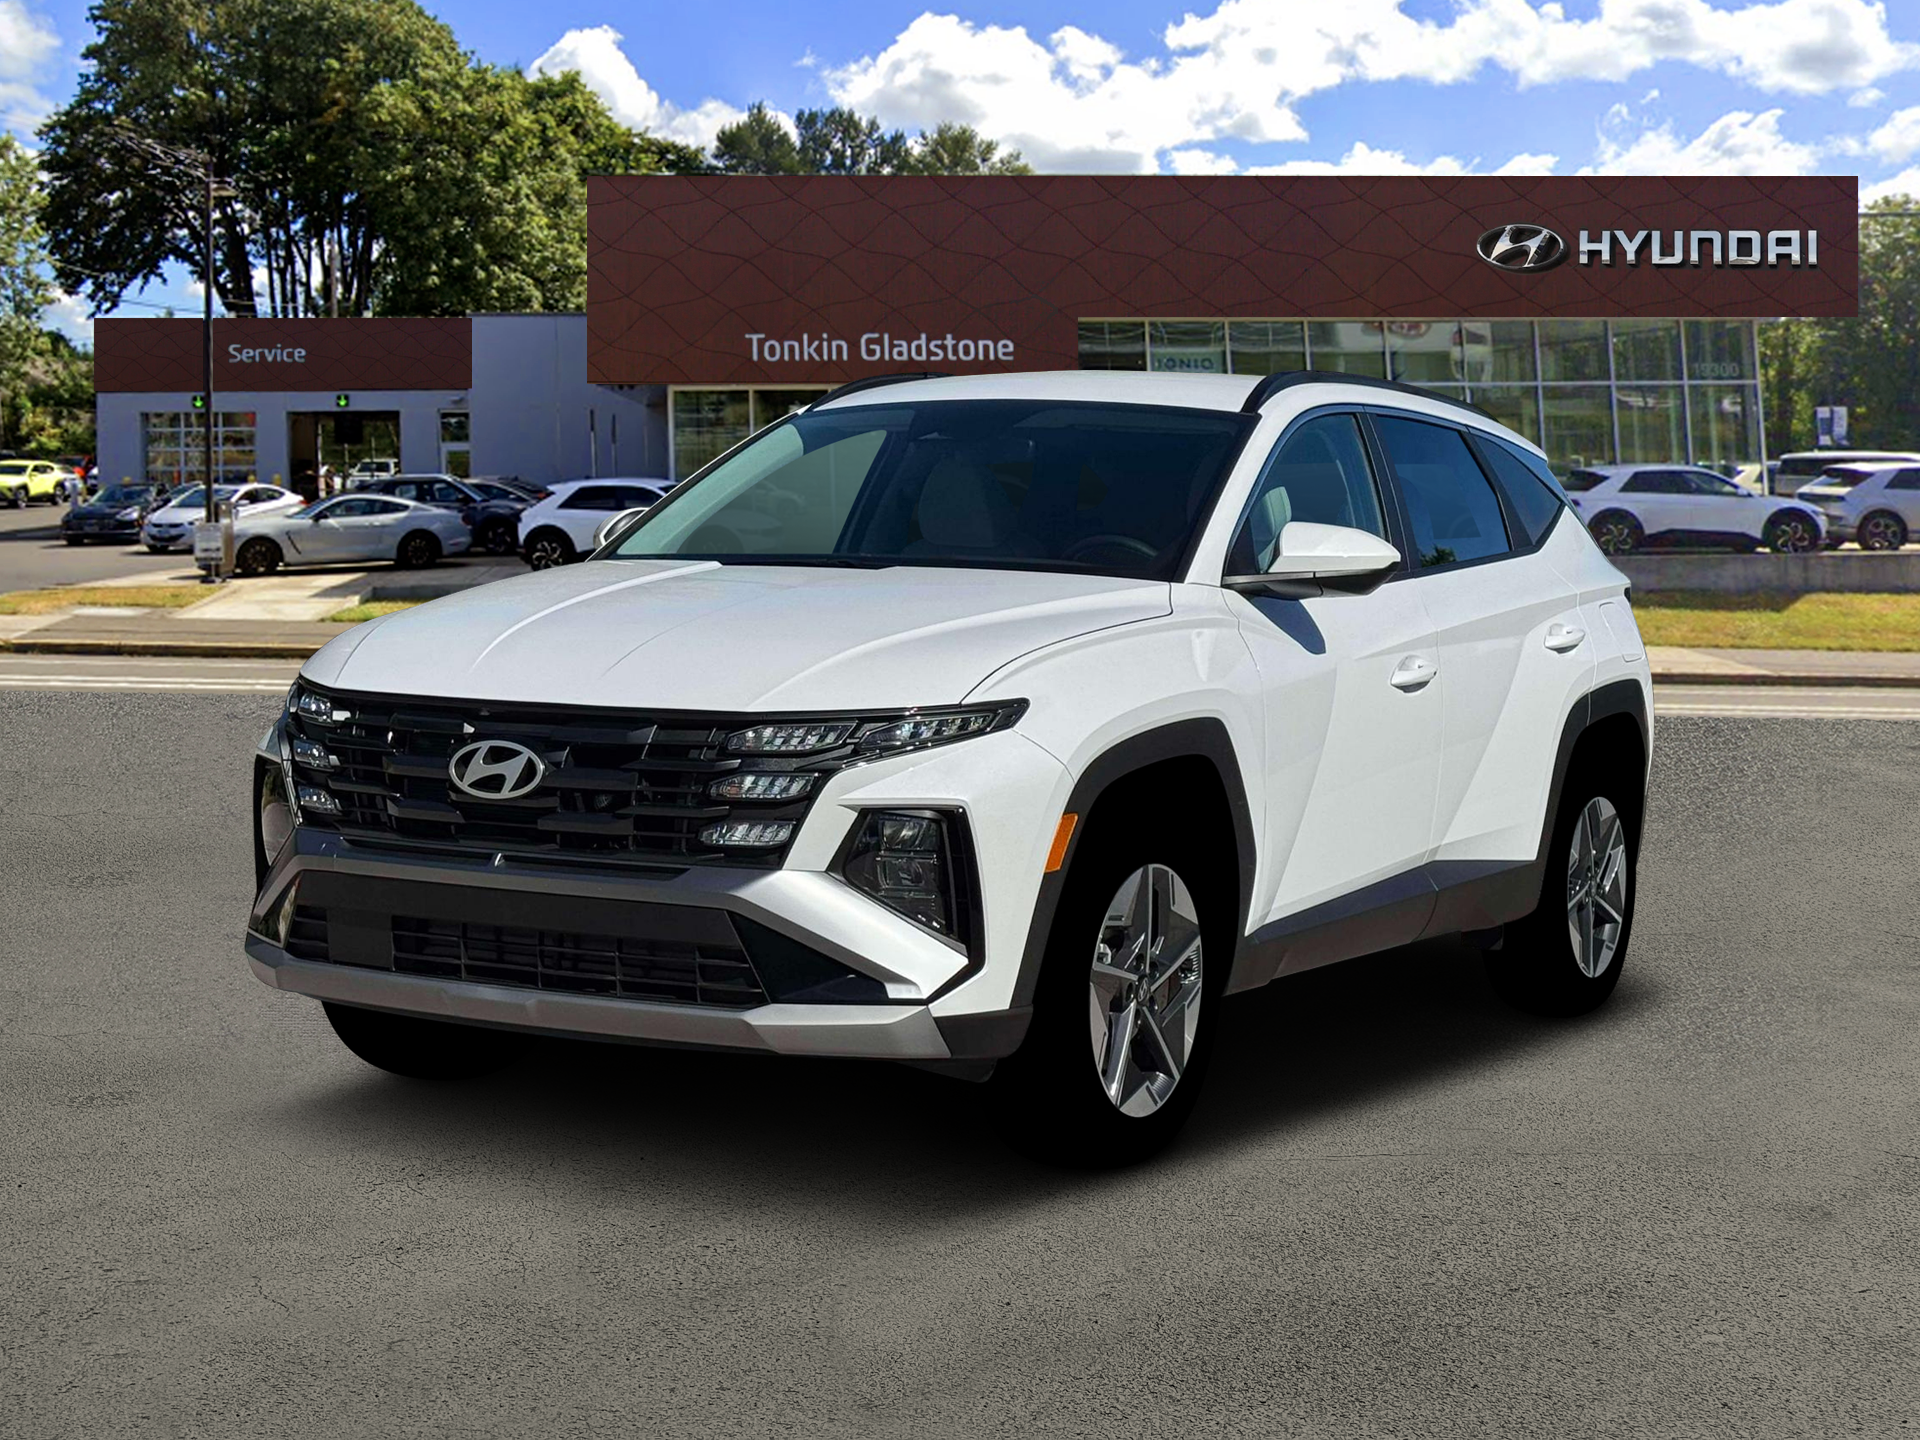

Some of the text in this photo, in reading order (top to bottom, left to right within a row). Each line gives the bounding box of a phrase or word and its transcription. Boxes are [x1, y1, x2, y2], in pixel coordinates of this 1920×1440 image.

[1579, 230, 1817, 266] HYUNDAI
[227, 343, 307, 363] Service
[744, 332, 1015, 362] Tonkin Gladstone
